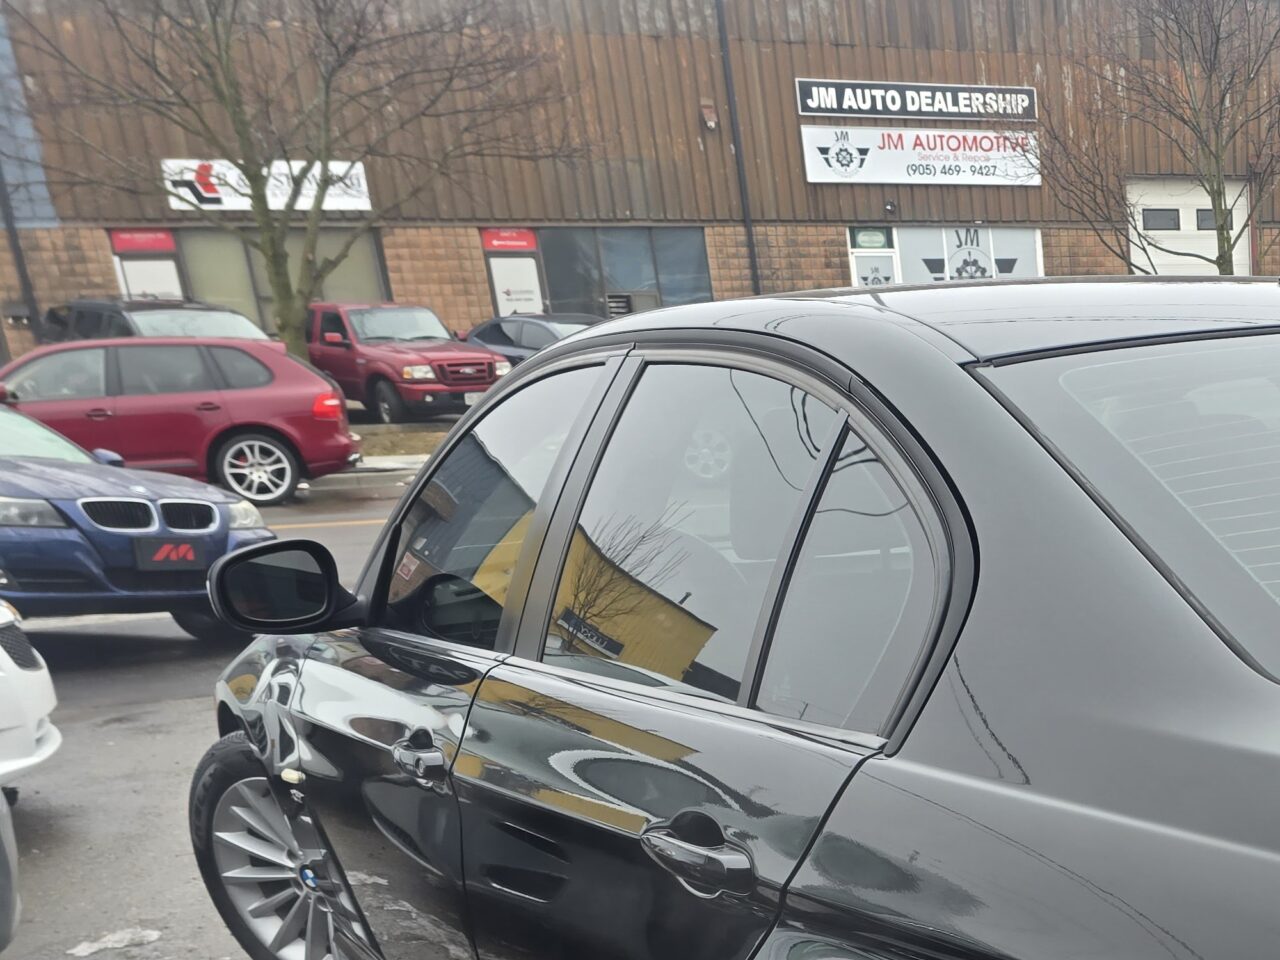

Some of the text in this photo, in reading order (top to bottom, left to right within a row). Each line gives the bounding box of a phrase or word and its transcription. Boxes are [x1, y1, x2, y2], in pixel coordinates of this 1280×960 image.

[806, 86, 1030, 114] JM AUTO DEALERSHIP
[877, 132, 1030, 152] JM AUTOMOTIVE
[906, 164, 937, 177] (905)
[955, 228, 980, 249] JM
